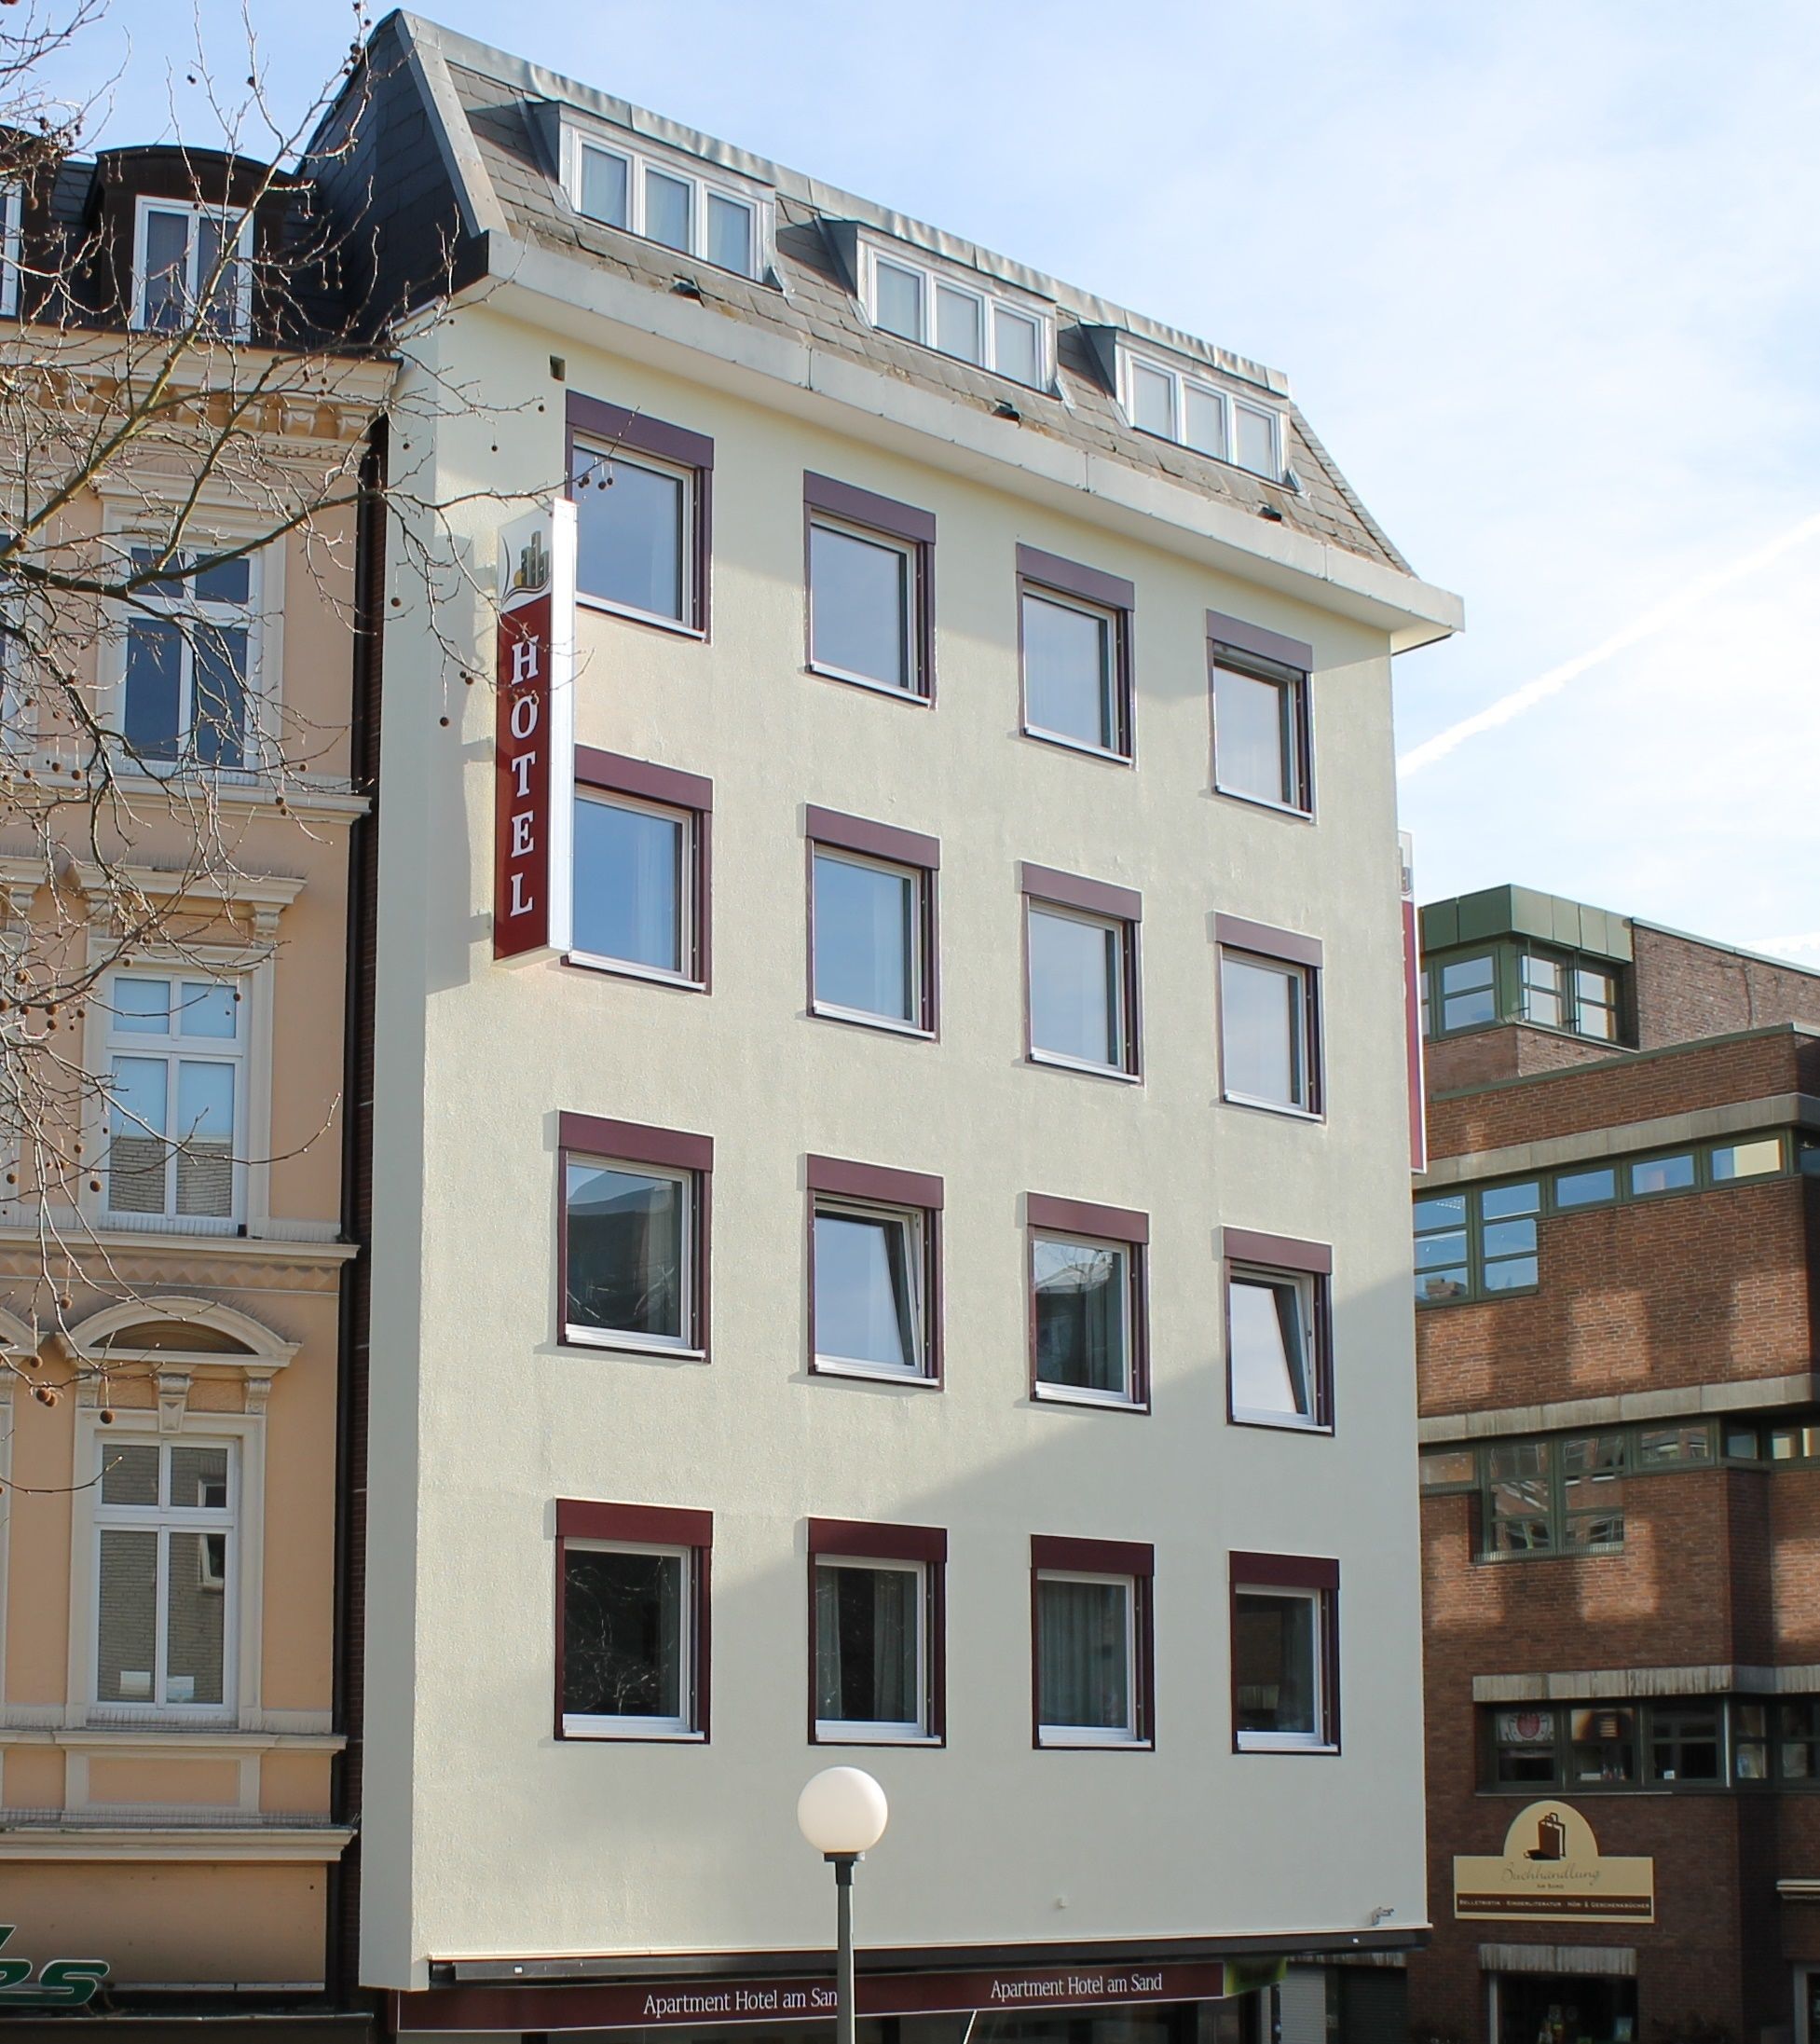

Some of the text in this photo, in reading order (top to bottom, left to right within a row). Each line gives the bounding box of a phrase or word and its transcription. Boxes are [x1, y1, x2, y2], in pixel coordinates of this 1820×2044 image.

[510, 635, 539, 917] HOTEL
[1500, 1862, 1599, 1886] Buchhandlung
[643, 1987, 838, 2018] Apartment Hotel am San
[991, 1973, 1163, 2002] Apartment Hotel am Sand
